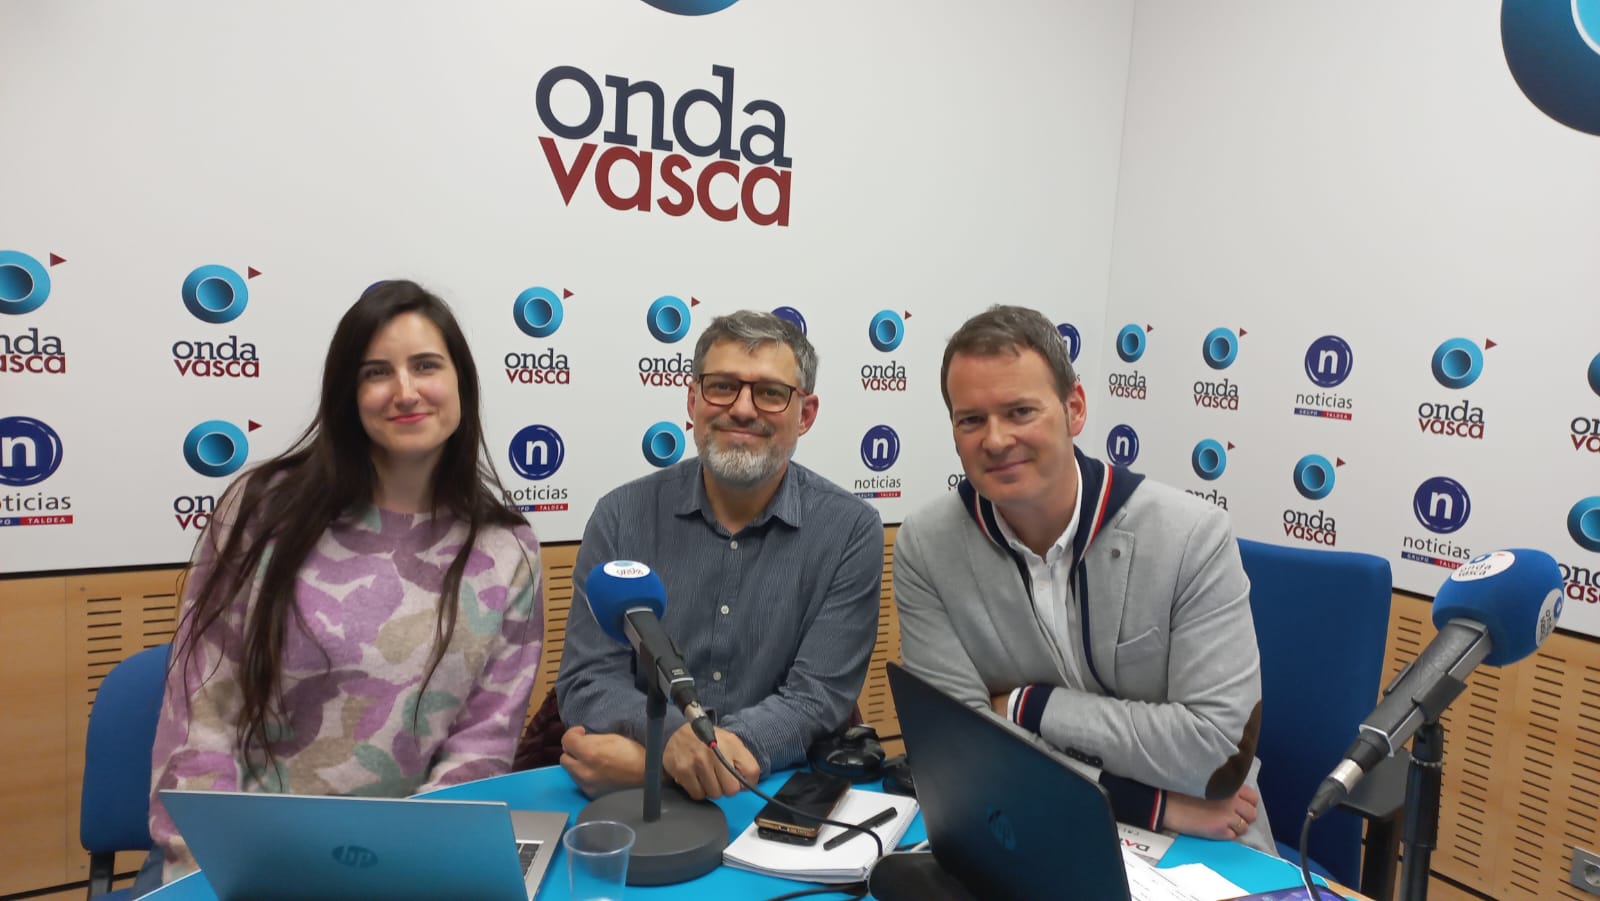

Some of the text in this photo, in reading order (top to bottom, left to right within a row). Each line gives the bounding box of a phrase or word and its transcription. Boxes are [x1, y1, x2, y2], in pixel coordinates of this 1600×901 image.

[536, 64, 792, 168] onda
[538, 136, 792, 227] vasca
[0, 327, 65, 356] nda
[172, 335, 259, 360] onda
[175, 359, 260, 377] vasca
[504, 348, 570, 370] onda
[639, 352, 693, 373] onda
[861, 361, 907, 379] onda
[1318, 350, 1338, 374] n
[505, 368, 570, 384] vasca
[861, 377, 907, 391] vasca
[1109, 370, 1146, 388] onda
[1109, 385, 1147, 400] vasca
[1193, 378, 1239, 398] onda
[1193, 394, 1239, 411] vasca
[1295, 392, 1353, 409] noticias
[1418, 400, 1484, 424] onda
[1418, 418, 1485, 440] vasca
[1, 436, 36, 467] n
[526, 440, 547, 465] n
[872, 437, 889, 459] n
[853, 475, 902, 489] noticias
[0, 492, 71, 512] ticias
[173, 495, 215, 514] on
[1429, 491, 1453, 520] n
[28, 516, 66, 525] TALDEA
[1283, 509, 1336, 533] onda
[1283, 522, 1336, 547] vasca
[1403, 535, 1471, 560] noticias
